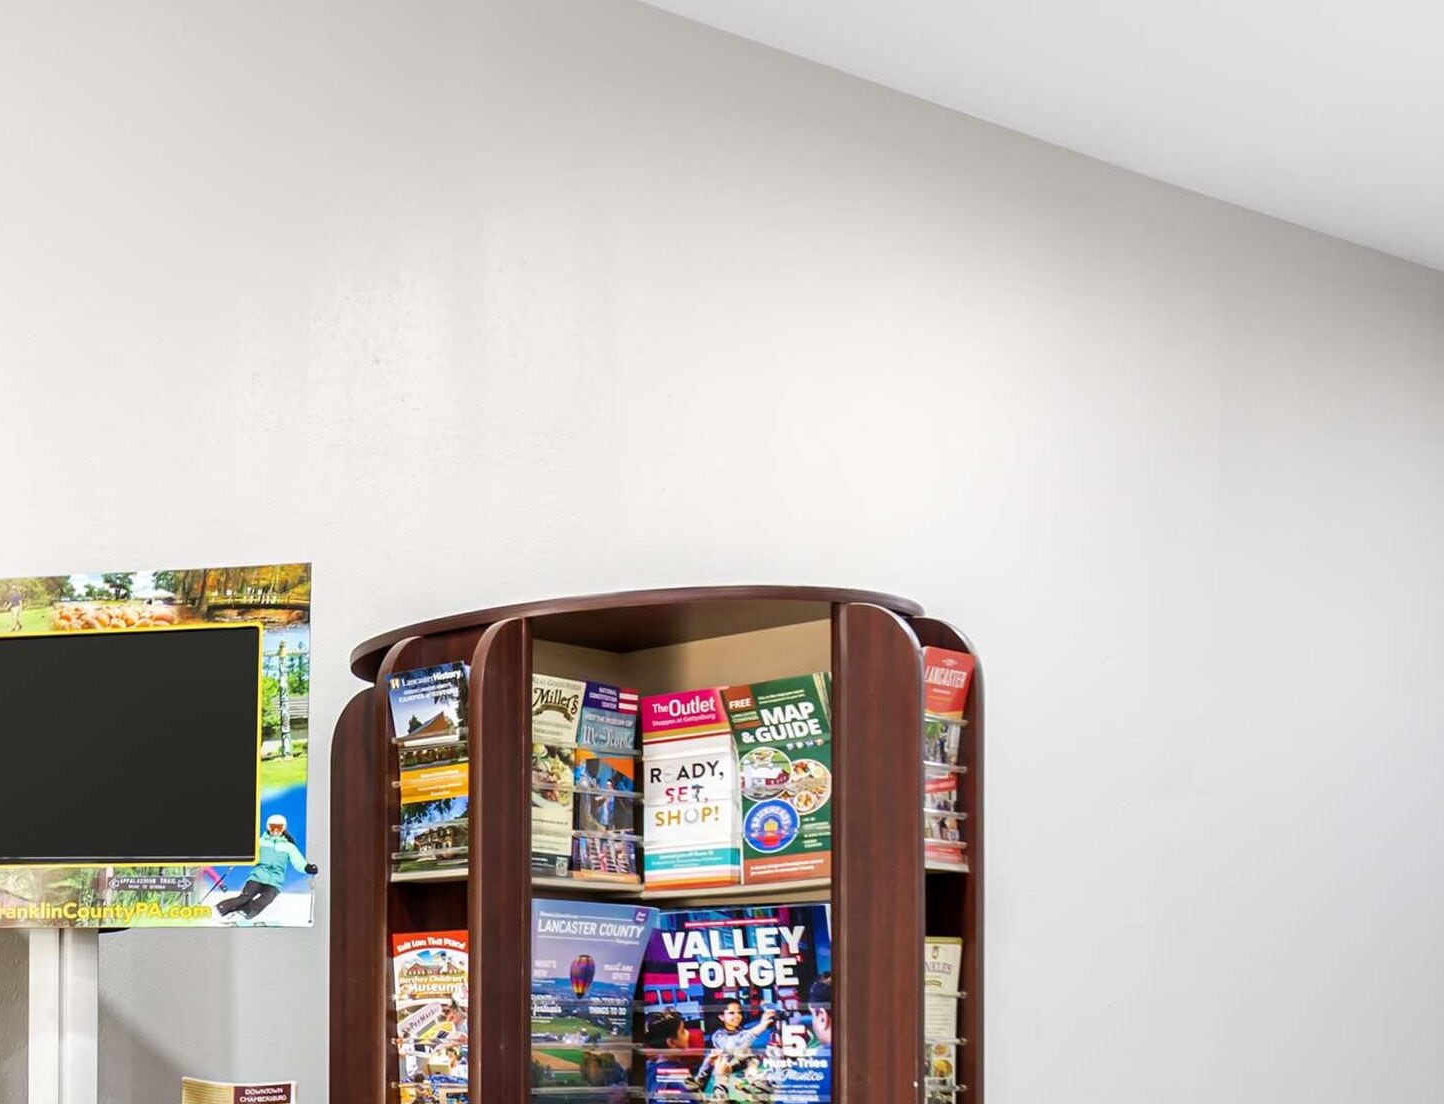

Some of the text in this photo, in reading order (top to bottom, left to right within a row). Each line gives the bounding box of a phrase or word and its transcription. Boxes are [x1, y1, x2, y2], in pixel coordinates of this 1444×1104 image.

[652, 704, 668, 714] The
[668, 696, 716, 717] Outlet
[729, 698, 752, 709] FREE
[760, 701, 815, 726] MAP
[654, 805, 719, 828] SHOP!
[538, 919, 645, 939] LANCASTER COUNTY
[662, 925, 806, 960] VALLEY
[676, 957, 800, 989] FORGE
[782, 1024, 808, 1057] 5
